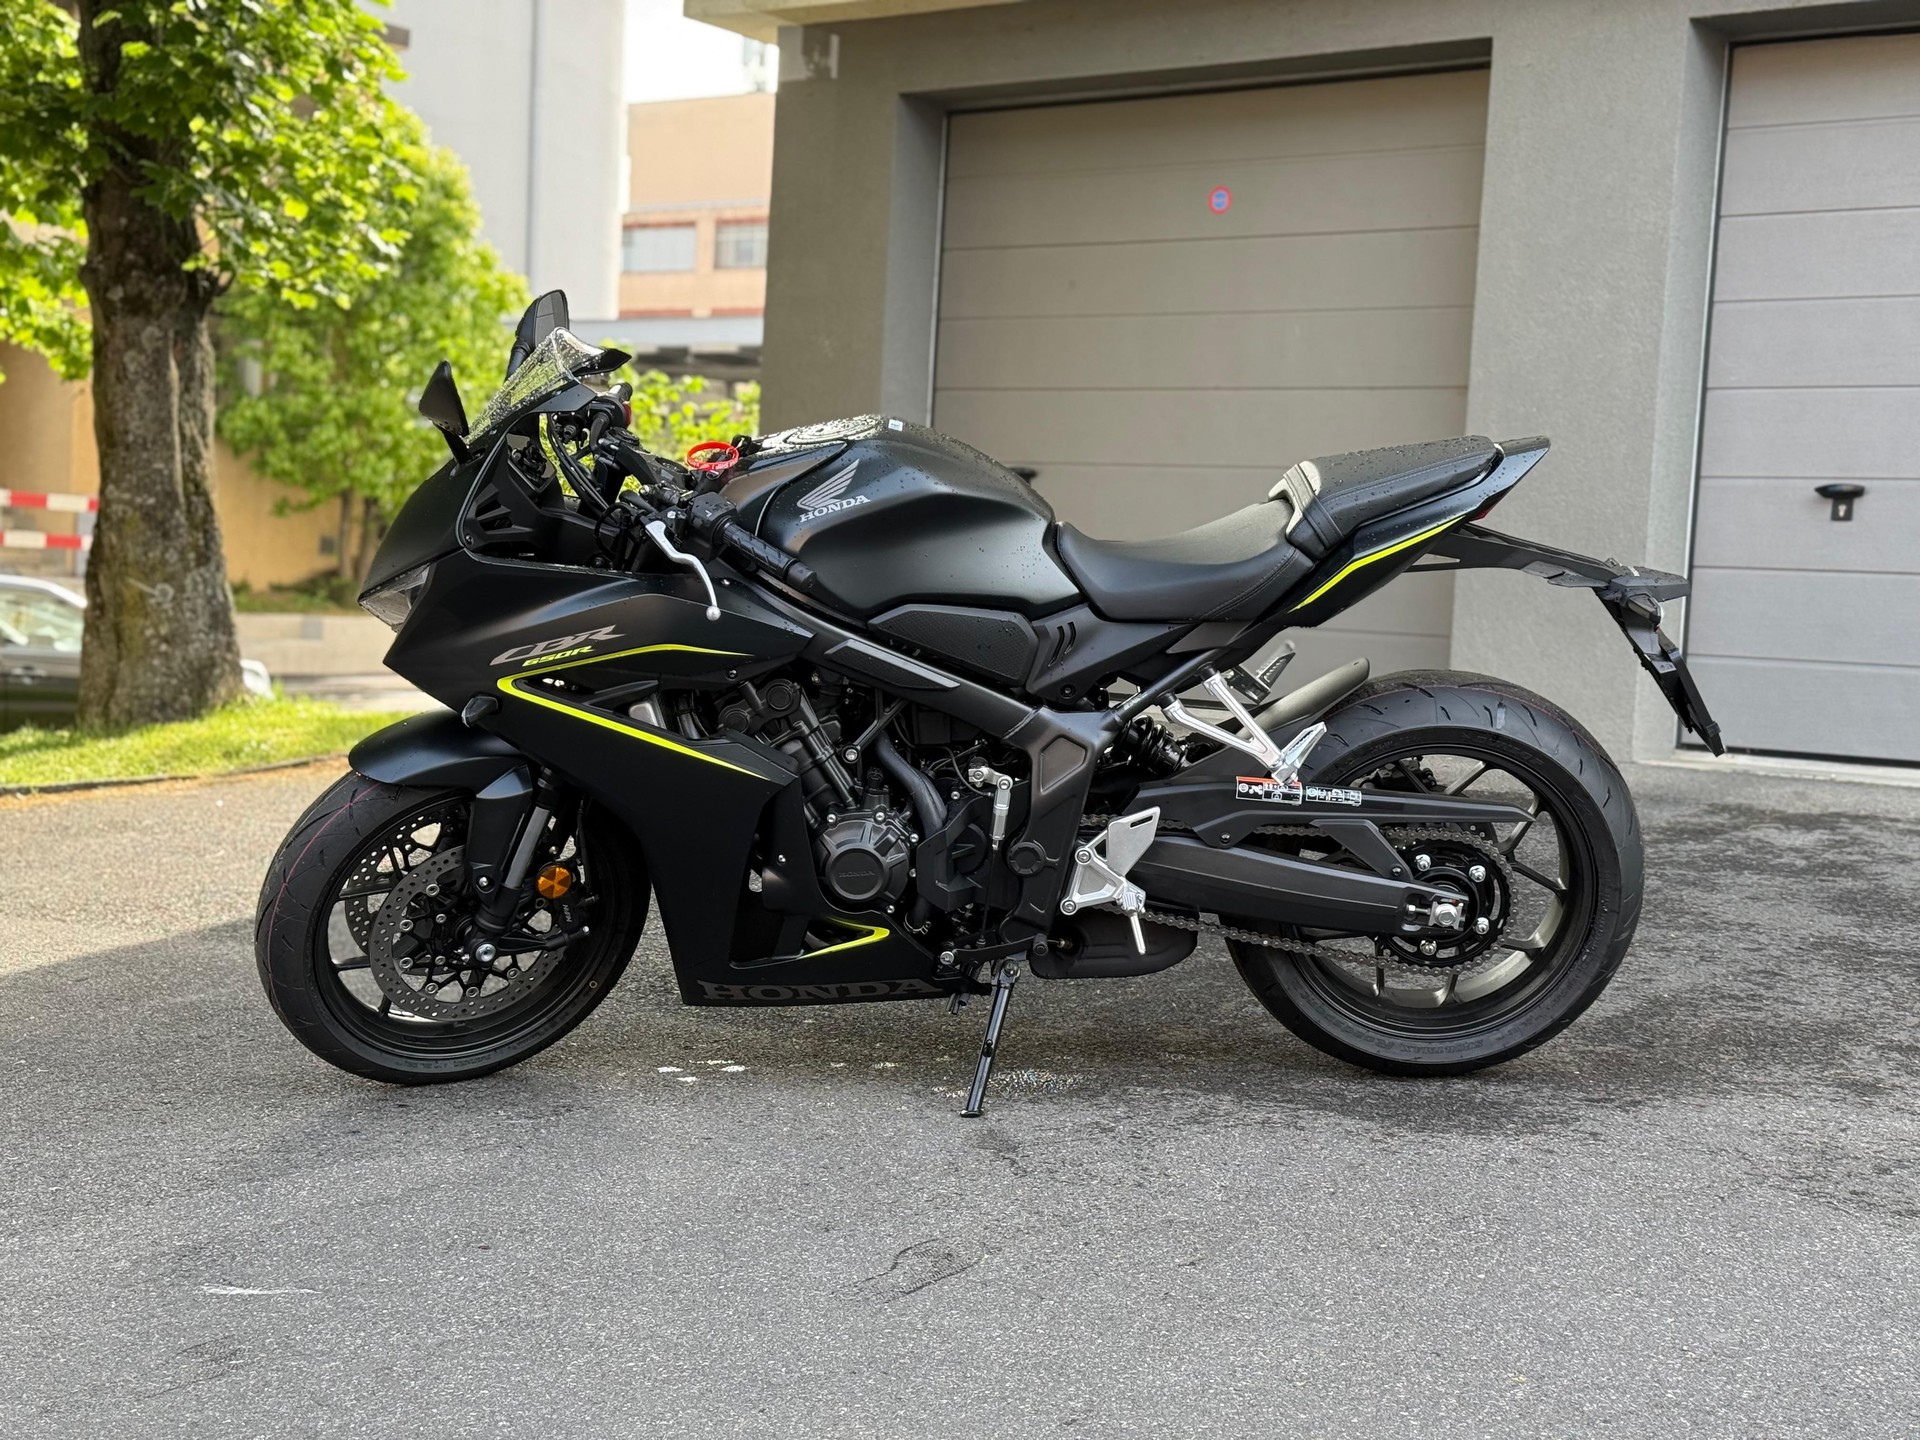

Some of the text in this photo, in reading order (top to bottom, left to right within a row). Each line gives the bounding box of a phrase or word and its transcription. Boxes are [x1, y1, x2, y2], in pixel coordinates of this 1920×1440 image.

[800, 495, 871, 522] HONDA
[489, 624, 627, 666] CBR
[522, 645, 597, 667] 650R
[838, 870, 877, 878] HONDA
[697, 978, 944, 1001] HONDA
